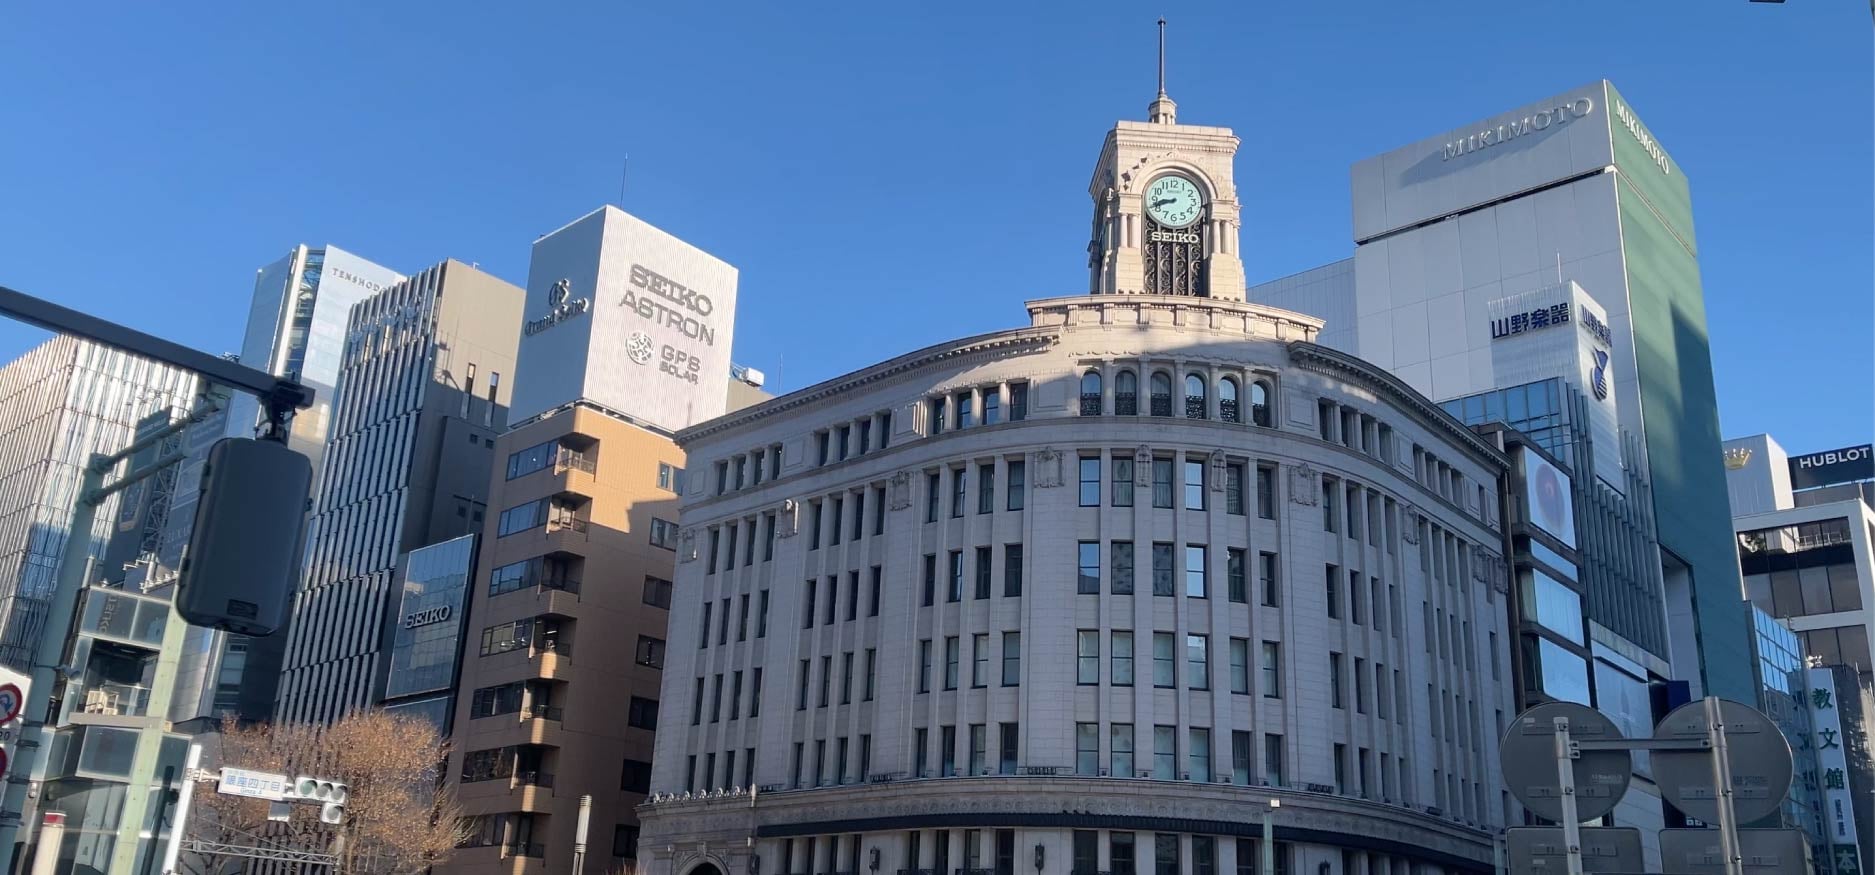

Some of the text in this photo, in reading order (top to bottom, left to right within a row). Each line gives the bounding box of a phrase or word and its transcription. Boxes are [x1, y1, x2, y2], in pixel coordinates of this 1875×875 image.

[1442, 97, 1593, 162] MIKIMOTO
[1616, 100, 1669, 174] MIKIMOTO
[1151, 231, 1199, 243] SEIKO
[629, 263, 713, 316] SEIKO
[618, 290, 714, 346] ASTRON
[1491, 302, 1570, 339] 山野楽器
[659, 361, 699, 384] SOLAR
[661, 344, 700, 372] GPS
[1799, 447, 1869, 469] HUBLOT
[404, 604, 450, 629] SEIKO
[1812, 688, 1845, 790] 教文館
